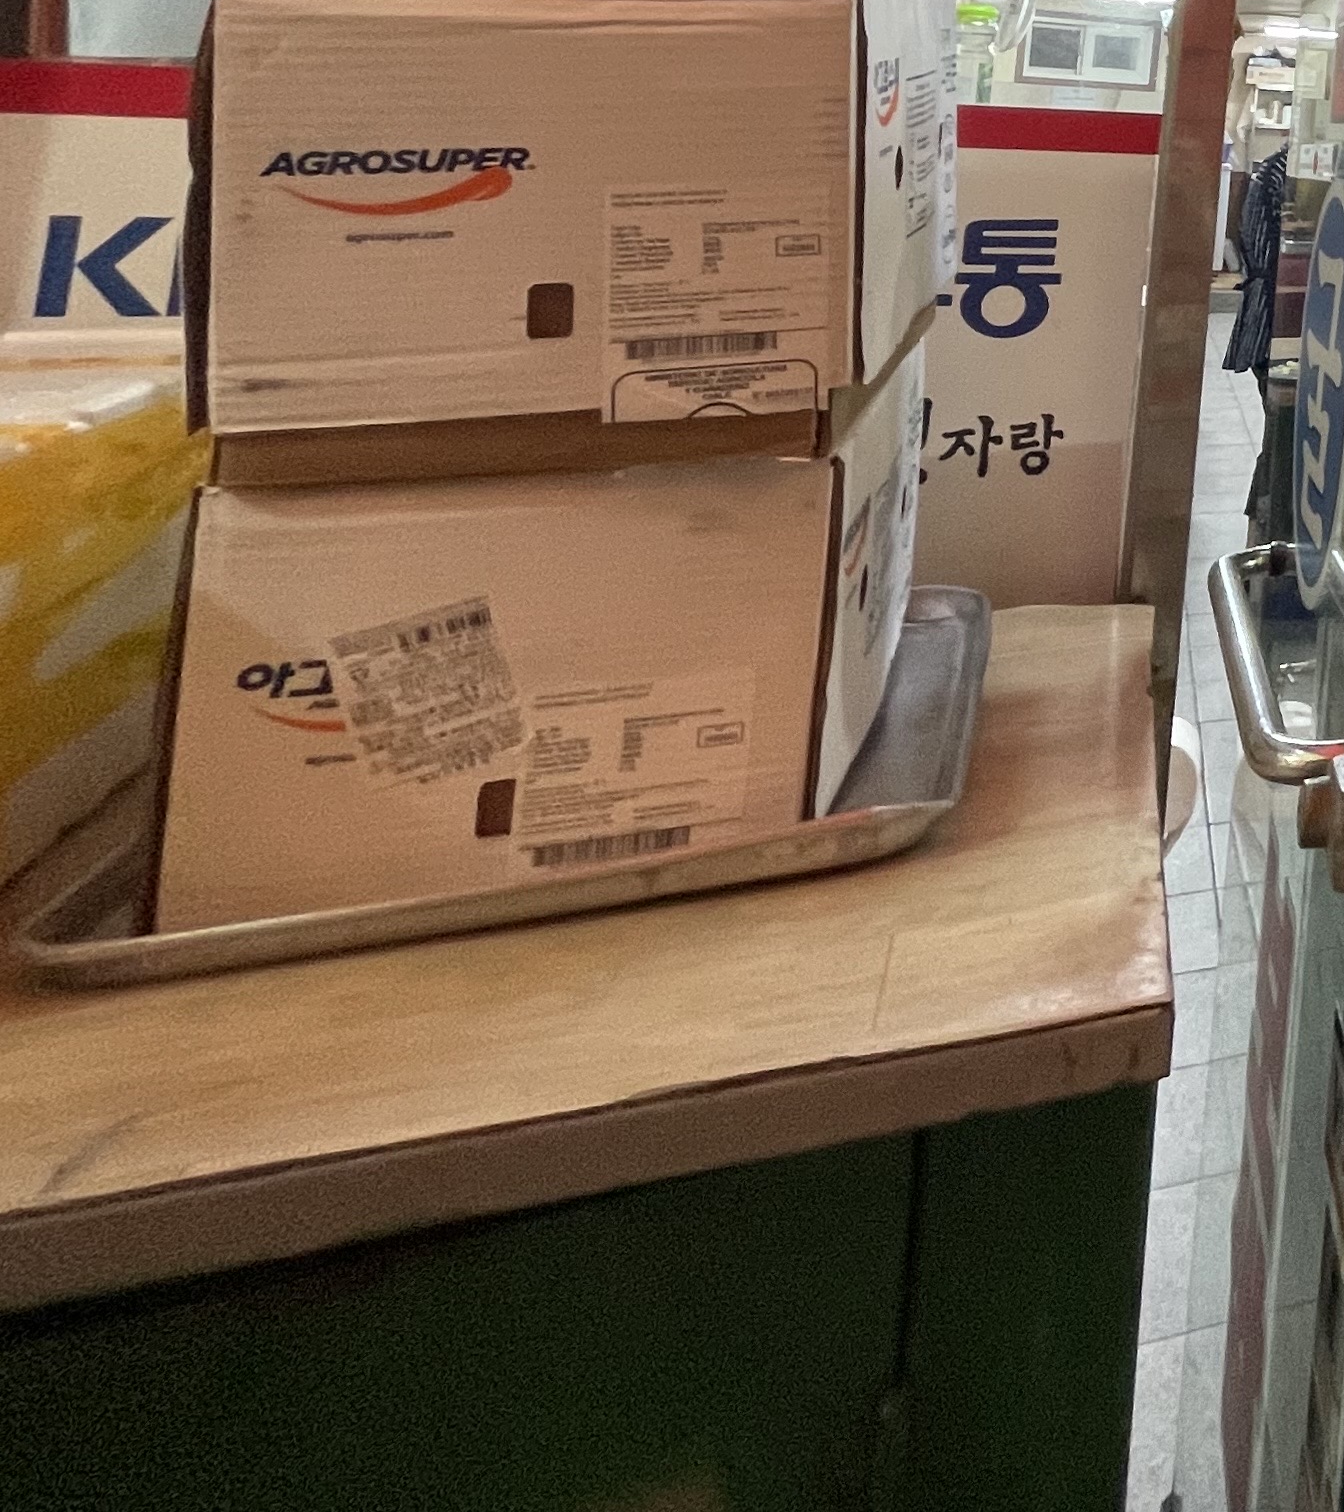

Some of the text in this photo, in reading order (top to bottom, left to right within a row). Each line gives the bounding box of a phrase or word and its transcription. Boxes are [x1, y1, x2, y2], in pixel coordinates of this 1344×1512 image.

[260, 147, 530, 177] AGROSUPER
[935, 219, 1062, 338] 통
[919, 397, 1064, 485] 자랑
[236, 659, 333, 699] 아그
